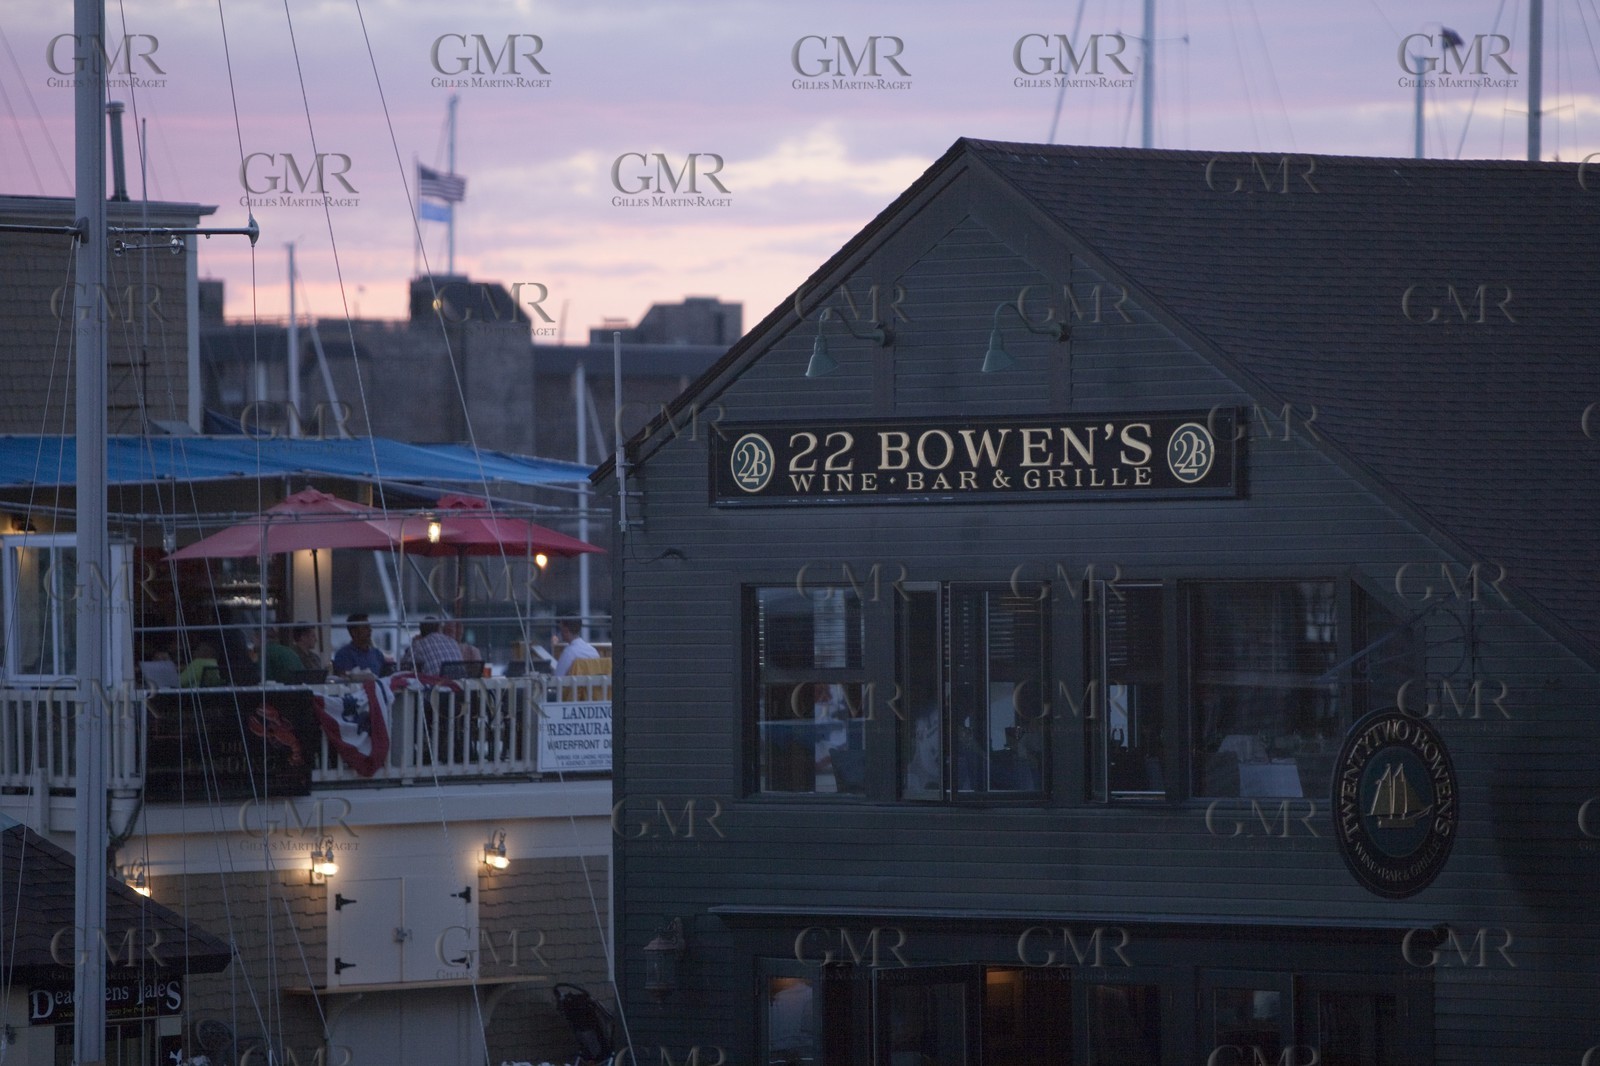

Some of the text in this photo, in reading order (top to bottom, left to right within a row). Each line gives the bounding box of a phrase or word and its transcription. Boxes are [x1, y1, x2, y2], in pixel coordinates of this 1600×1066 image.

[788, 423, 1152, 472] 22 BOWEN'S
[788, 467, 1152, 492] WINE BAR & GRILLE
[548, 722, 612, 736] RESTAURA
[546, 739, 600, 751] WATERFRONT
[30, 989, 75, 1019] Dea
[105, 983, 129, 1001] ens
